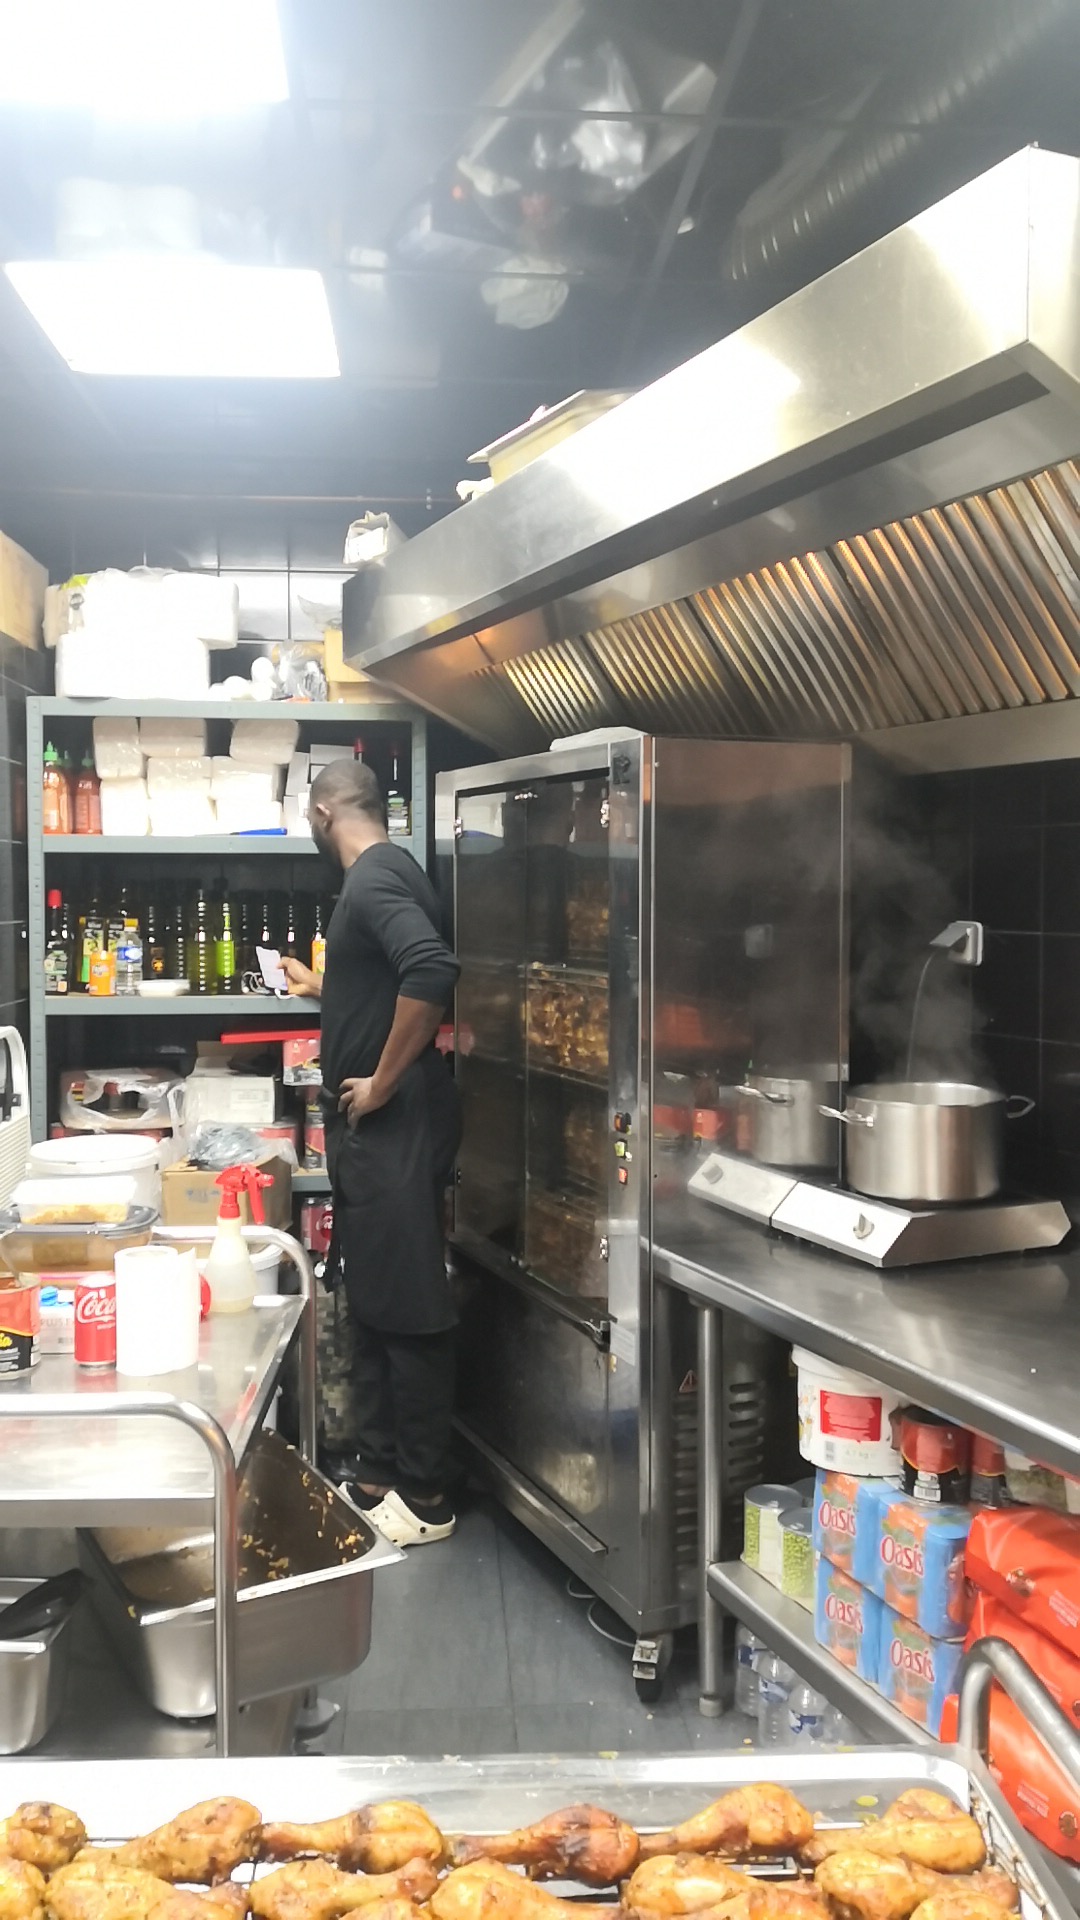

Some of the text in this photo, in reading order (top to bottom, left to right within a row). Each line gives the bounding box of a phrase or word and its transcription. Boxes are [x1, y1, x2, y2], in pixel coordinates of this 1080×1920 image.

[819, 1500, 857, 1537] Oasis
[881, 1535, 925, 1578] Oasis
[825, 1593, 864, 1635] Oasis
[891, 1639, 936, 1683] Oasis
